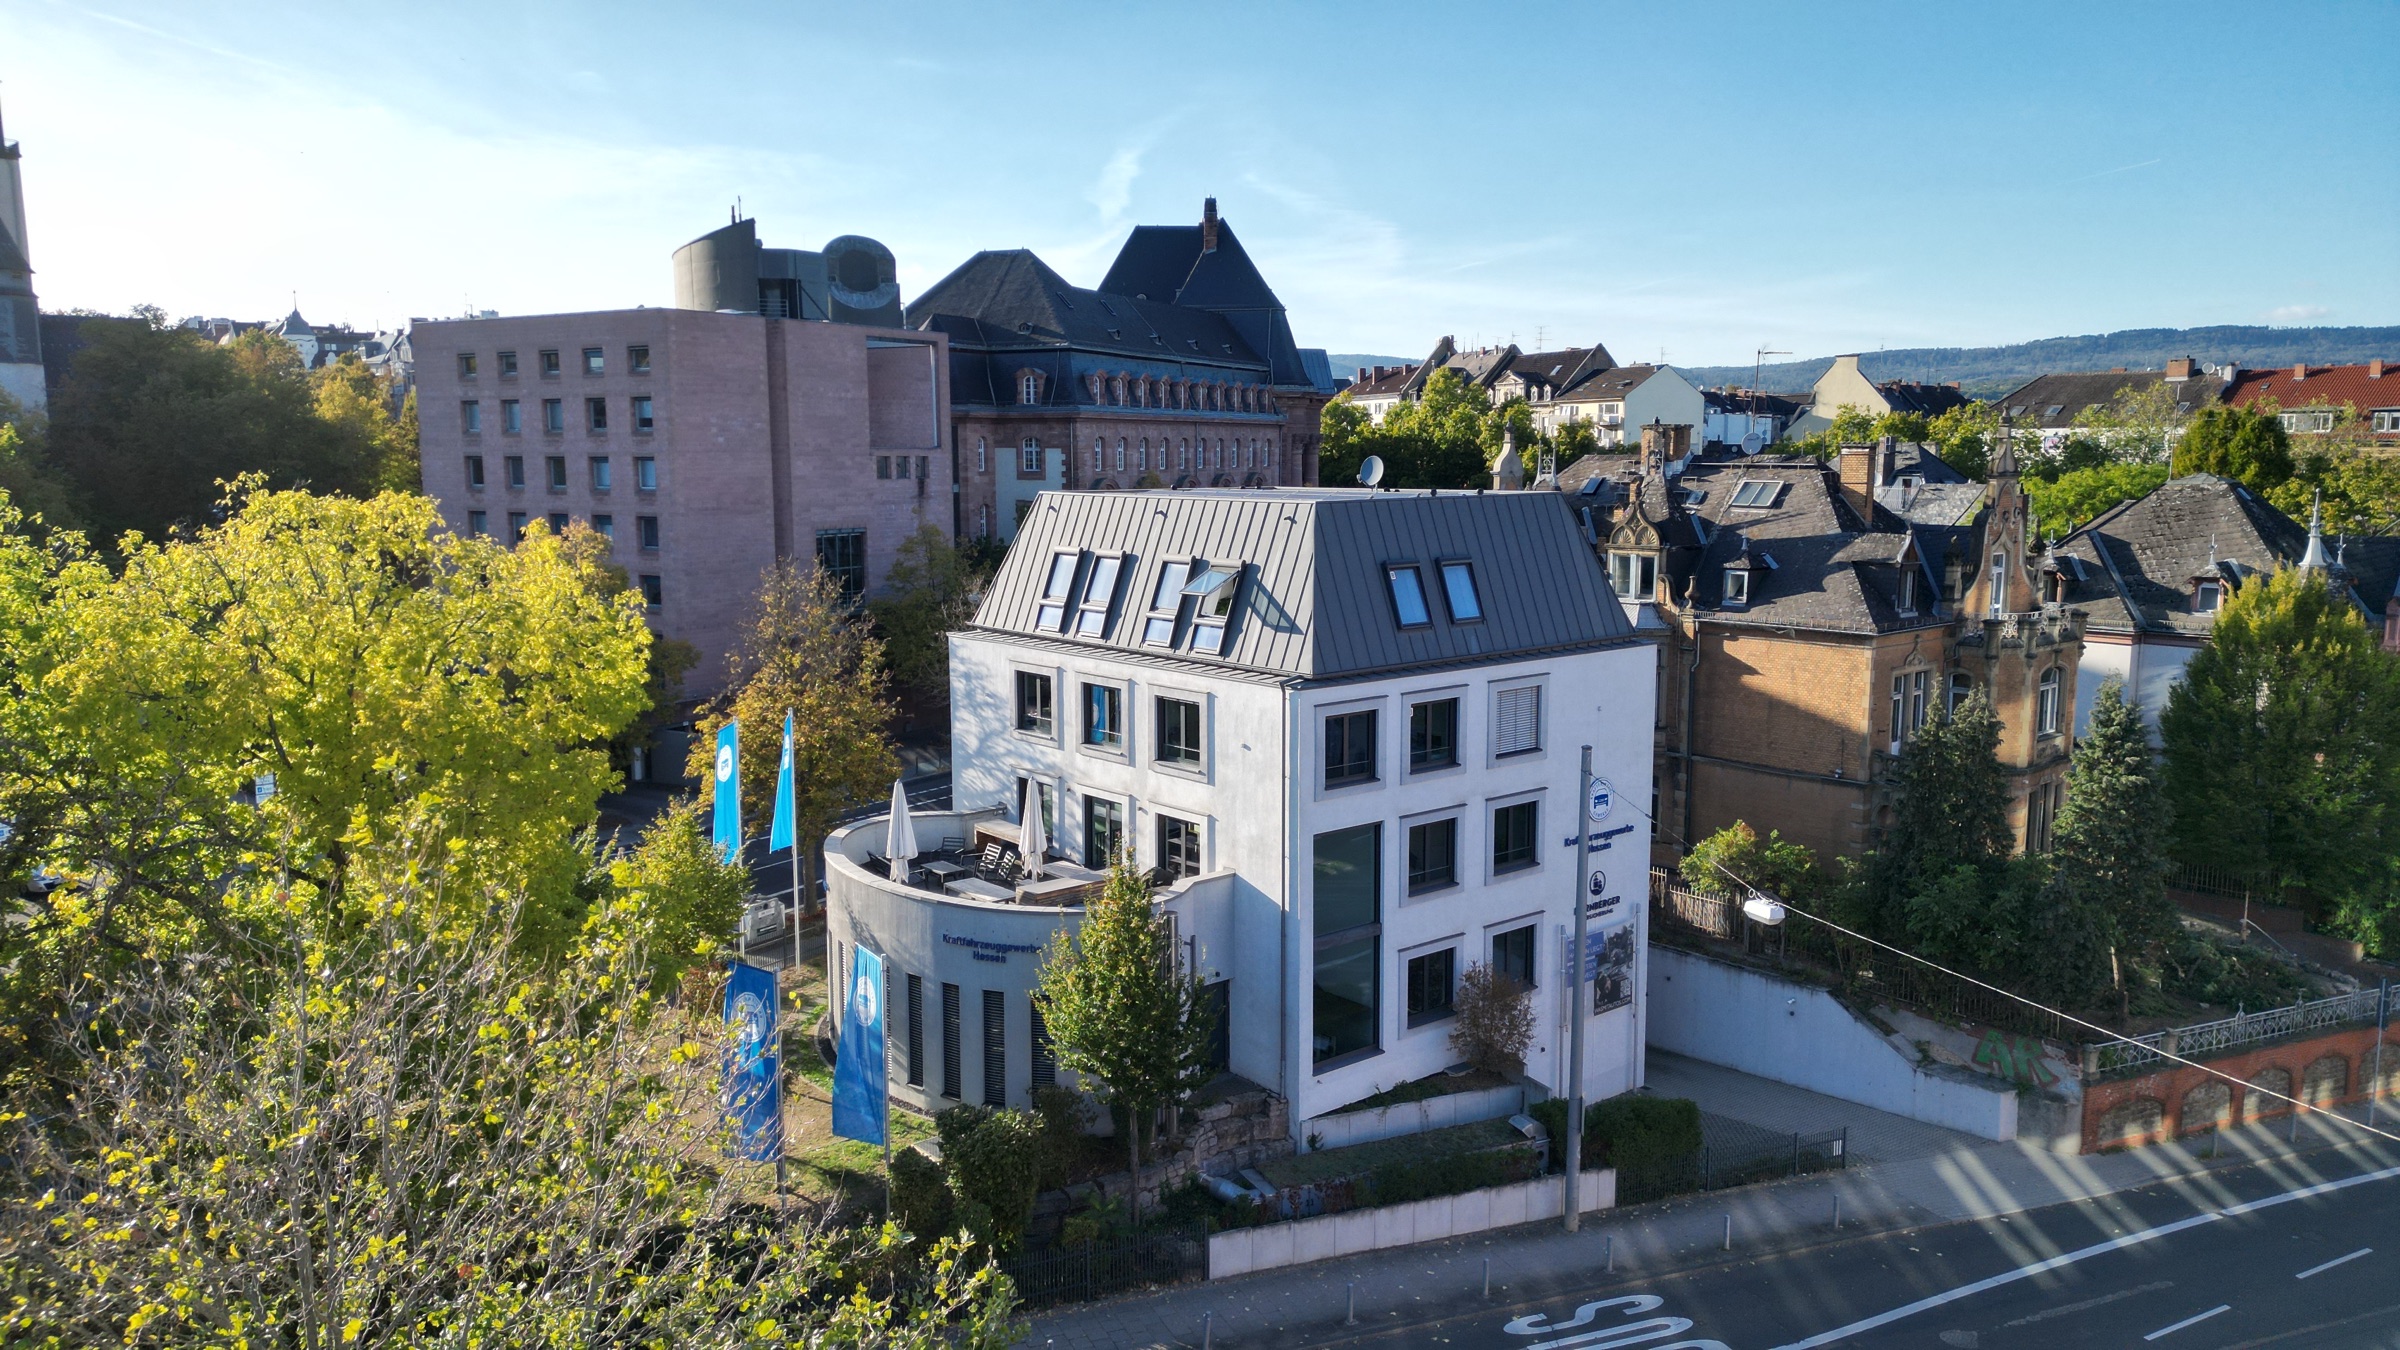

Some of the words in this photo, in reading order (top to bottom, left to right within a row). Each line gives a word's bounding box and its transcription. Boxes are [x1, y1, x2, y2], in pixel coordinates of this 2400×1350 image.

[942, 933, 1042, 954] Kraftfahrzeuggewerbe
[973, 951, 1007, 964] Hessen
[1503, 1294, 1736, 1350] US
